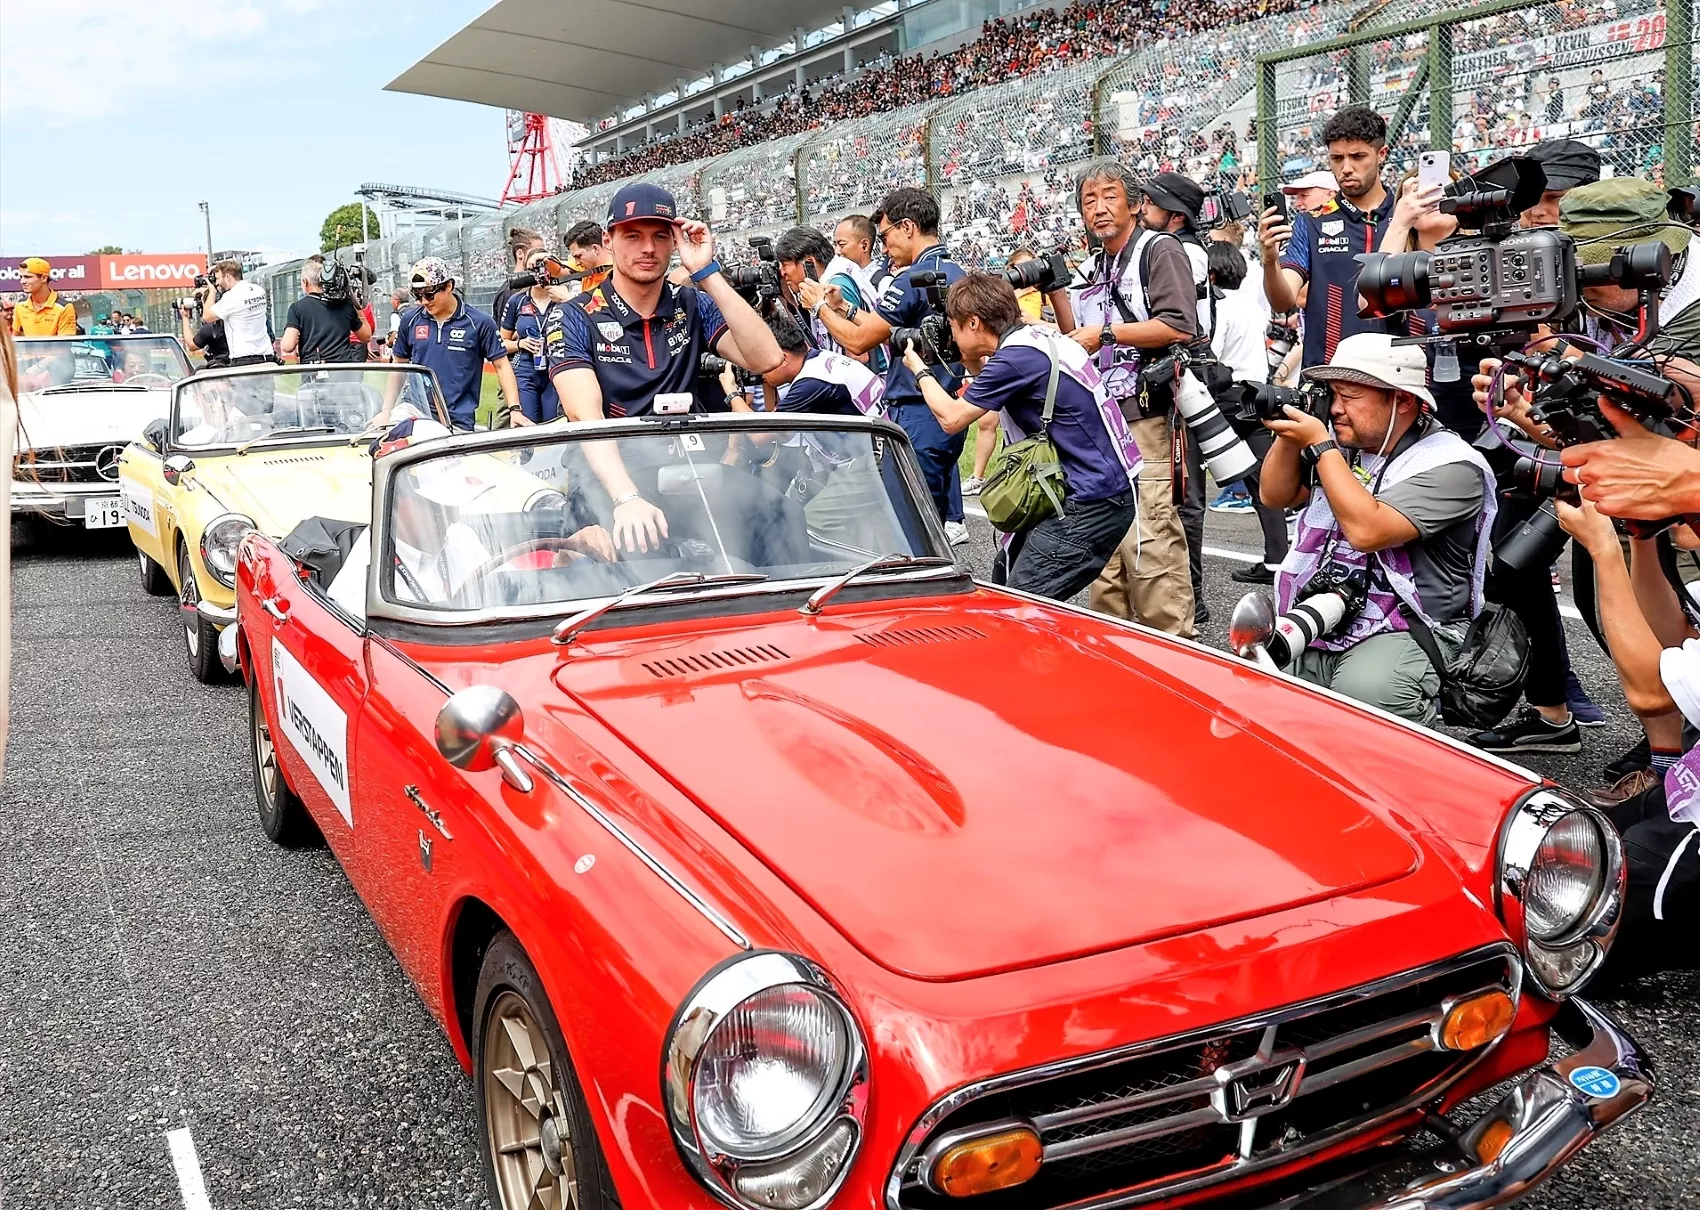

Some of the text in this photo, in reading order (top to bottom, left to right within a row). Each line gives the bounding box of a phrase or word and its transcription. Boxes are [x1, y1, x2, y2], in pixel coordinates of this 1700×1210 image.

[1555, 32, 1591, 53] KEVIN
[1552, 41, 1634, 66] MAGNUSSEN
[1452, 50, 1508, 75] UENTHER
[625, 202, 636, 216] 1
[1341, 198, 1357, 213] zoom
[1318, 246, 1349, 254] ORACLE
[1499, 237, 1533, 247] SONY
[50, 267, 66, 279] or
[67, 264, 85, 279] all
[109, 261, 200, 281] Lenovo
[610, 292, 629, 317] zoom
[598, 355, 632, 364] ORACLE
[287, 695, 345, 791] VERSTAPPEN
